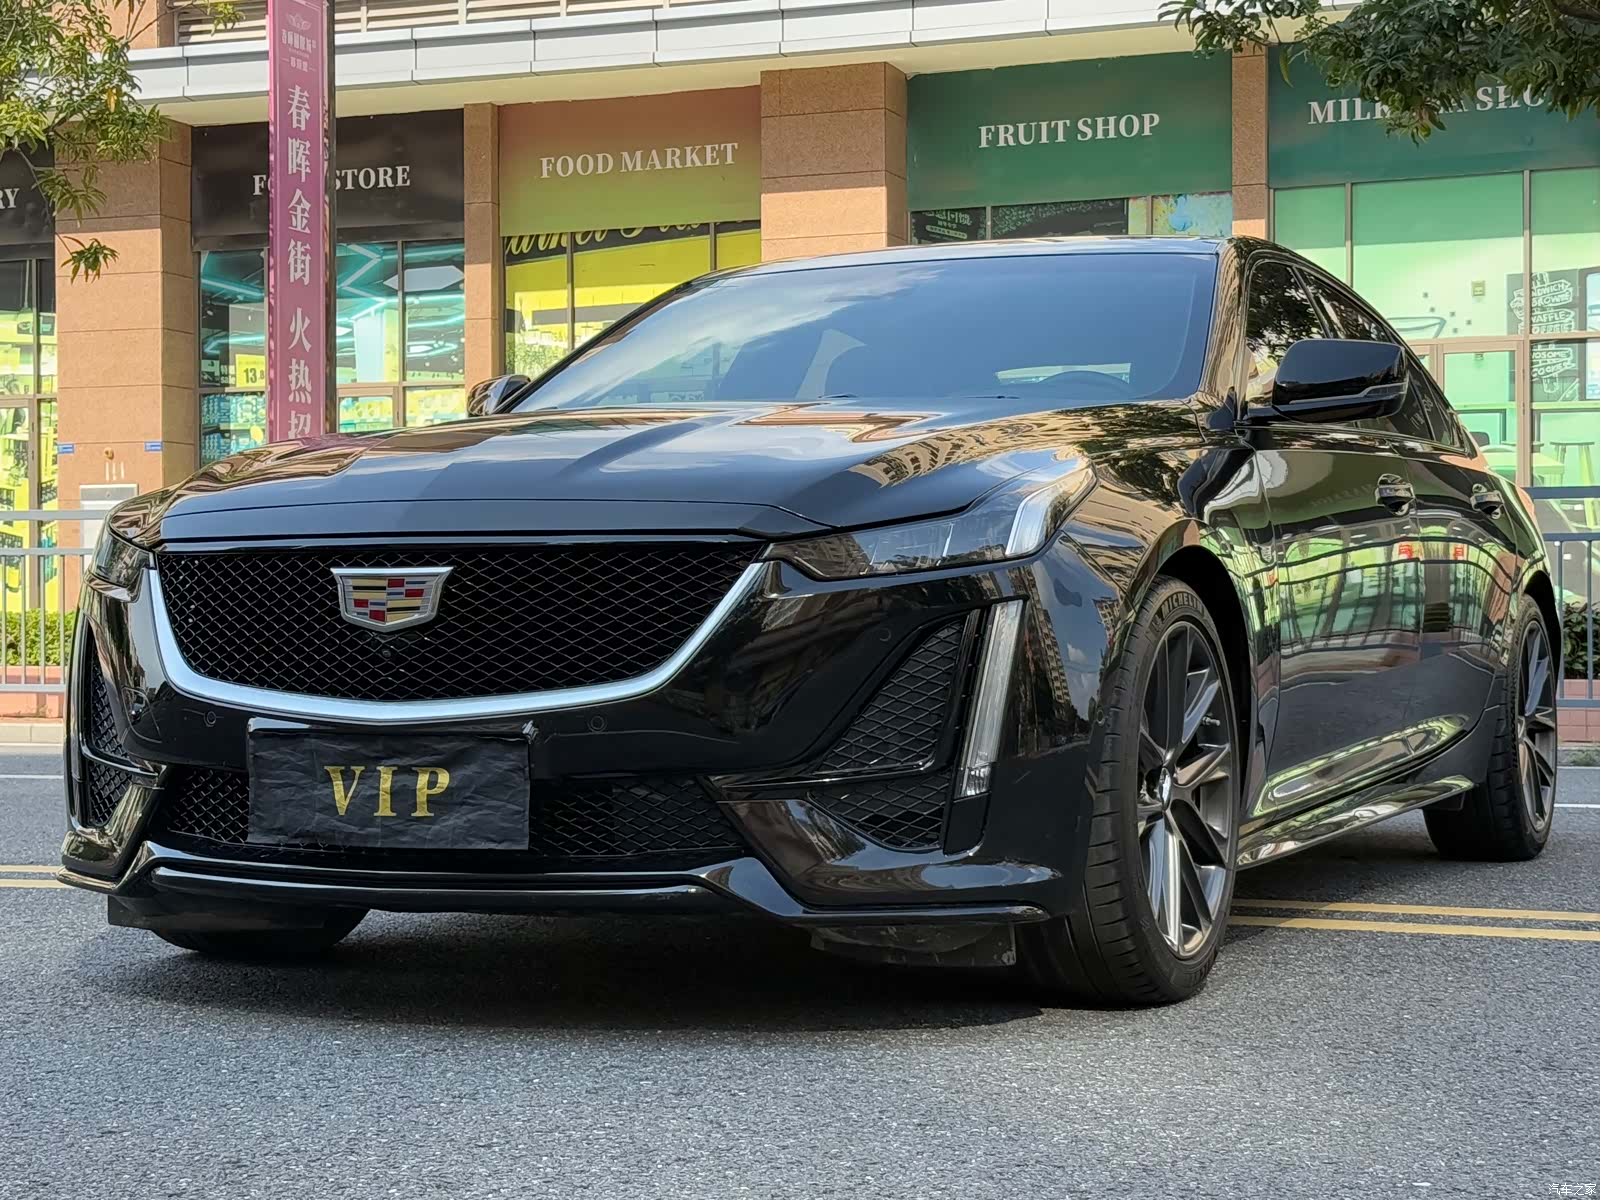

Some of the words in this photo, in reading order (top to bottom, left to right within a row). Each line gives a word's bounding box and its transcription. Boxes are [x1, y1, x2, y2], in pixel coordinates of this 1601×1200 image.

[978, 119, 1070, 148] FRUIT
[1077, 112, 1160, 141] SHOP
[540, 152, 614, 178] FOOD
[620, 142, 739, 173] MARKET
[287, 84, 312, 286] 春晖金街
[323, 765, 451, 817] VIP
